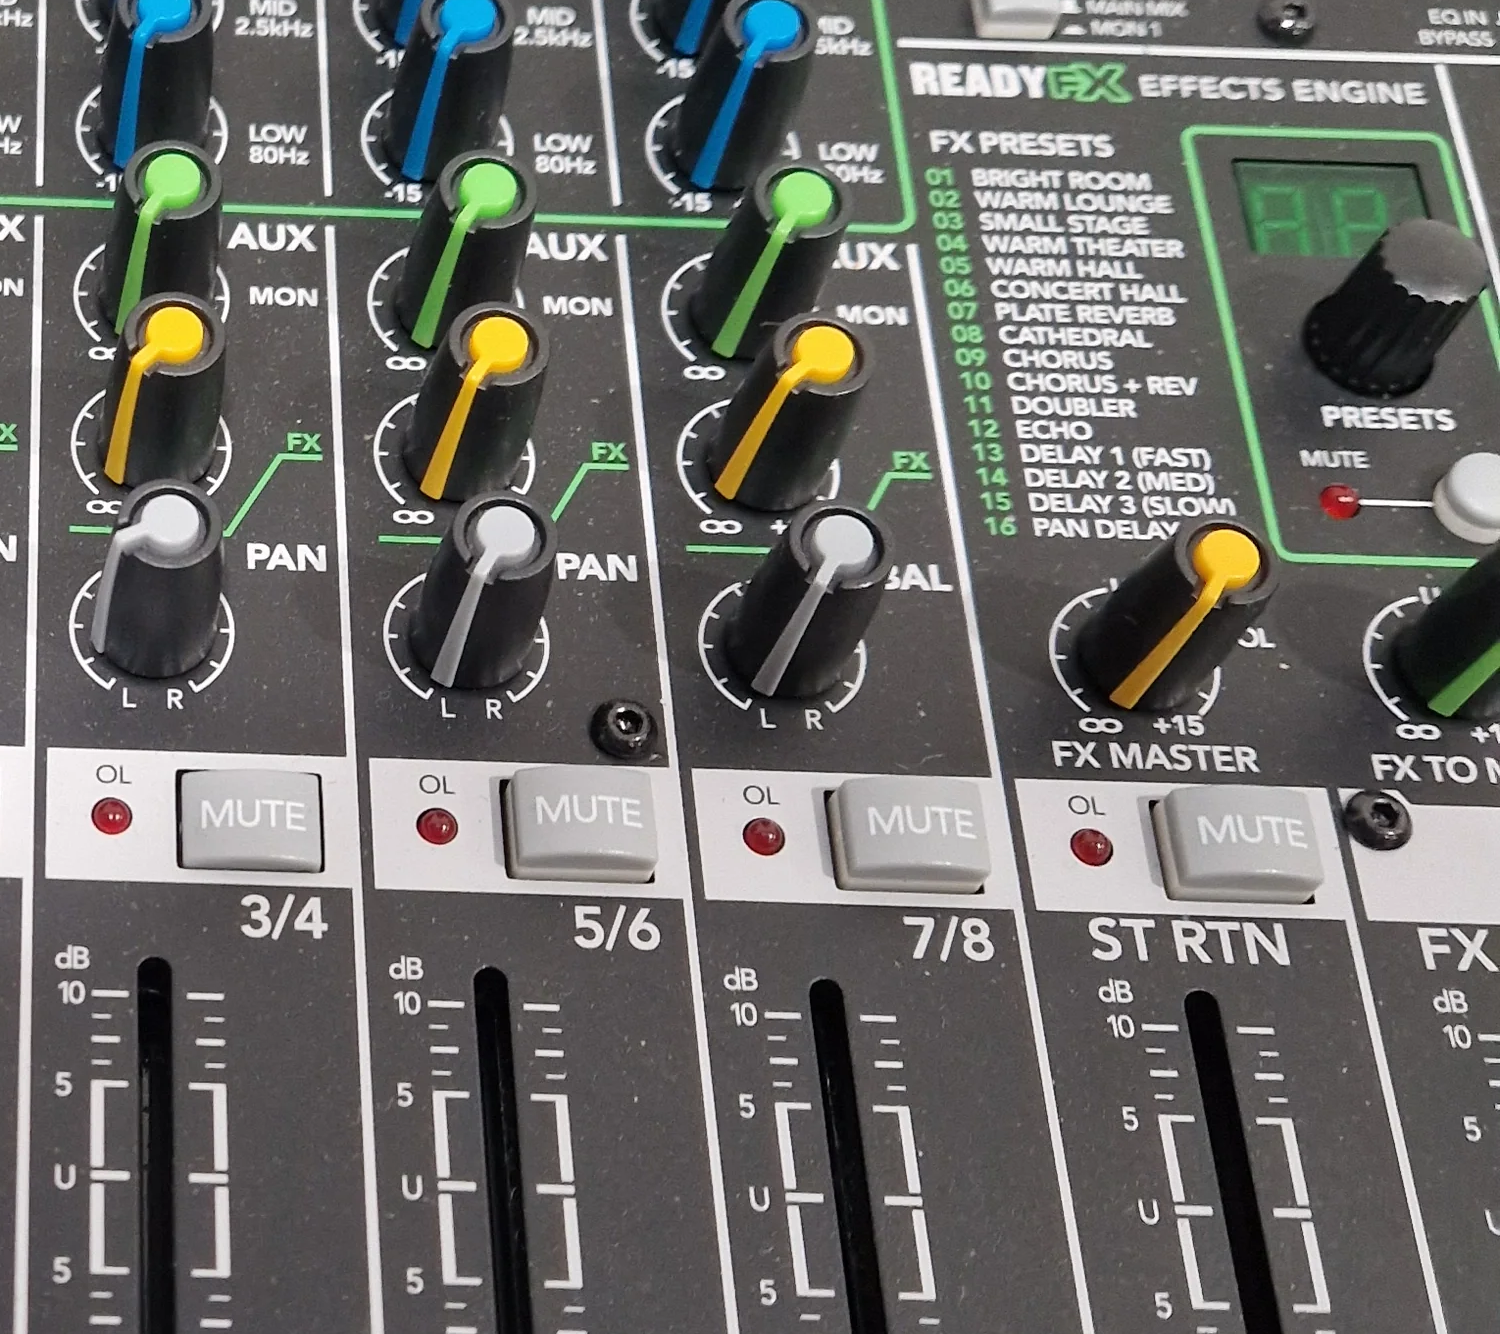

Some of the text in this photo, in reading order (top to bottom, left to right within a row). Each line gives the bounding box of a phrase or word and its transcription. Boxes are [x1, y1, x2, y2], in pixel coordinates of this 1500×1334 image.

[234, 17, 314, 38] 2.5kHz
[526, 6, 575, 27] MID
[513, 27, 593, 48] 2.5kHz
[1138, 78, 1285, 102] EFFECTS
[1293, 80, 1428, 105] ENGINE
[248, 124, 307, 145] LOW
[533, 133, 592, 154] LOW
[929, 130, 1115, 158] FX PRESETS
[248, 145, 310, 166] 80Hz
[535, 154, 597, 175] 80Hz
[925, 168, 1152, 191] 01 BRIGHT ROOM
[928, 190, 1175, 214] 02 WARM LOUNGE
[932, 213, 1150, 235] 03 SMALL STAGE
[227, 224, 317, 253] AUX
[525, 234, 609, 261] AUX
[935, 235, 1184, 259] 04 WARM THEATER
[939, 257, 1144, 279] 05 WARM HALL
[249, 287, 319, 306] MON
[943, 280, 1187, 304] 06 CONCERT HALL
[543, 296, 613, 317] MON
[946, 302, 1176, 326] 07 PLATE REVERB
[950, 324, 1154, 349] 08 CATHEDRAL
[955, 348, 1113, 370] 09 CHORUS
[959, 370, 991, 390] 10
[1006, 372, 1118, 394] CHORUS
[1147, 376, 1198, 397] REV
[962, 394, 1137, 418] 11 DOUBLER
[967, 418, 1093, 441] 12 ECHO
[1321, 406, 1456, 432] PRESETS
[287, 433, 321, 452] FX
[591, 442, 626, 461] FX
[971, 442, 1211, 471] 13 DELAY 1 (FAST)
[1299, 449, 1369, 470] MUTE
[975, 466, 1215, 494] 14 DELAY 2 (MED)
[979, 491, 1236, 518] 15 DELAY 3 (SLOW)
[984, 516, 1179, 540] 16 PAN DELAY
[247, 543, 327, 571] PAN
[556, 554, 638, 582] PAN
[1052, 741, 1260, 773] FX MASTER
[96, 764, 132, 785] OL
[419, 774, 456, 795] OL
[743, 785, 781, 806] OL
[1068, 796, 1106, 815] OL
[201, 799, 307, 831] MUTE
[536, 795, 643, 828] MUTE
[867, 806, 977, 840] MUTE
[1197, 815, 1308, 848] MUTE
[240, 895, 328, 940] 3/4
[574, 907, 661, 950] 5/6
[903, 915, 995, 962] 7/8
[1088, 918, 1291, 966] ST RTN
[1417, 927, 1499, 972] FX
[55, 945, 91, 969] dB
[723, 968, 759, 991] dB
[58, 981, 87, 1005] 10
[1098, 981, 1135, 1004] dB
[730, 1003, 758, 1027] 10
[1106, 1015, 1136, 1039] 10
